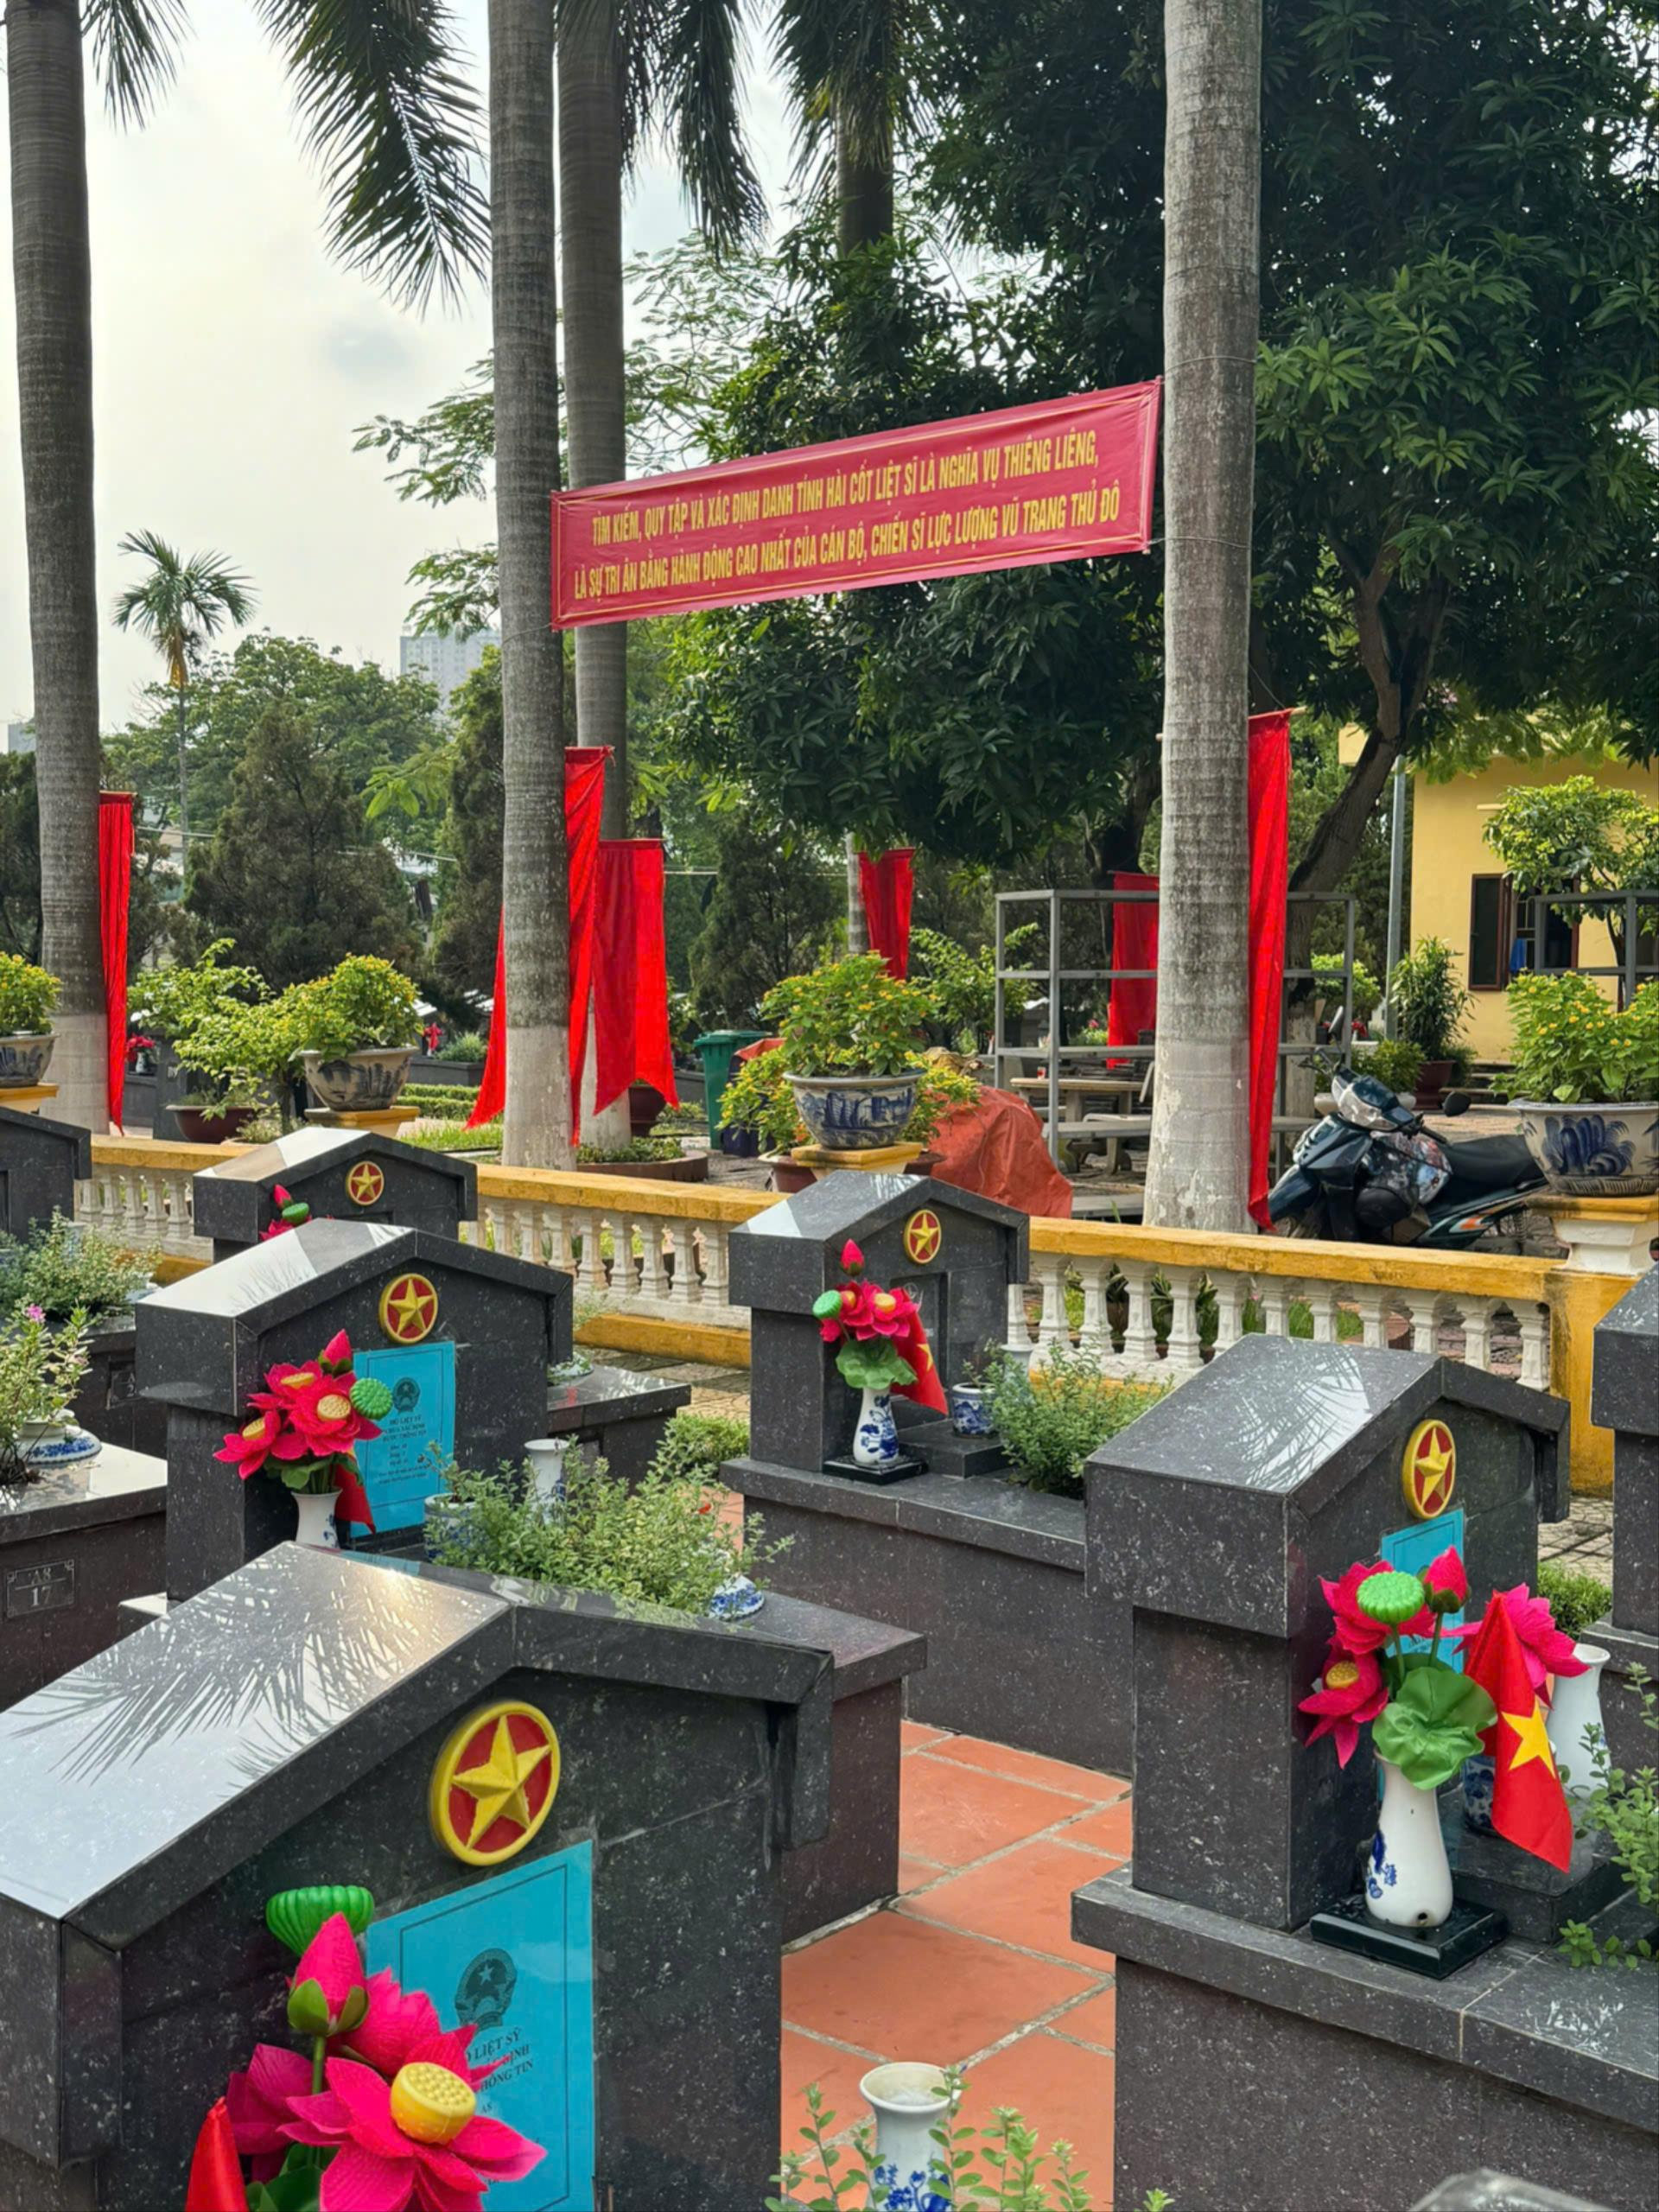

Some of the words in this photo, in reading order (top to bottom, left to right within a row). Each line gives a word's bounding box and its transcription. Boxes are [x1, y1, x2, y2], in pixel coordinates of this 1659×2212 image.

[592, 510, 610, 546] TÌM
[613, 502, 642, 543] KIẾM,
[644, 505, 665, 540] QUY
[668, 497, 689, 539] TẬP
[690, 493, 704, 530] VÀ
[707, 490, 730, 528] XÁC
[732, 490, 760, 530] ĐỊNH
[761, 484, 794, 518] DANH
[797, 474, 823, 513] TÍNH
[826, 468, 847, 508] HÀI
[849, 459, 874, 505] CỐT
[874, 459, 901, 505] LIỆT
[904, 455, 918, 496] SĨ
[919, 452, 936, 493] LÀ
[938, 446, 979, 490] NGHĨA
[983, 448, 1001, 488] VỤ
[1004, 434, 1052, 480] THIÊNG
[1054, 426, 1099, 468] LIÊNG,
[575, 564, 587, 600] LÀ
[589, 564, 604, 602] SỰ
[605, 564, 620, 595] TRI
[622, 556, 638, 593] ÂN
[639, 549, 669, 590] BẰNG
[671, 548, 701, 586] HÀNH
[702, 543, 733, 587] ĐỘNG
[735, 543, 758, 576] CAO
[760, 528, 791, 573] NHẤT
[793, 525, 817, 568] CỦA
[820, 524, 845, 564] CÁN
[848, 520, 868, 567] BỘ,
[871, 511, 909, 557] CHIẾN
[911, 512, 926, 551] SĨ
[927, 511, 952, 555] LỰC
[954, 505, 998, 550] LƯỢNG
[1001, 496, 1020, 537] VŨ
[1023, 494, 1067, 534] TRANG
[1071, 478, 1097, 527] THỦ
[1099, 479, 1120, 523] ĐÔ
[31, 1567, 52, 1585] A8
[30, 1586, 52, 1607] 17
[474, 2036, 503, 2060] LIỆT
[480, 2069, 513, 2092] HÔNG
[514, 2059, 534, 2075] TIN
